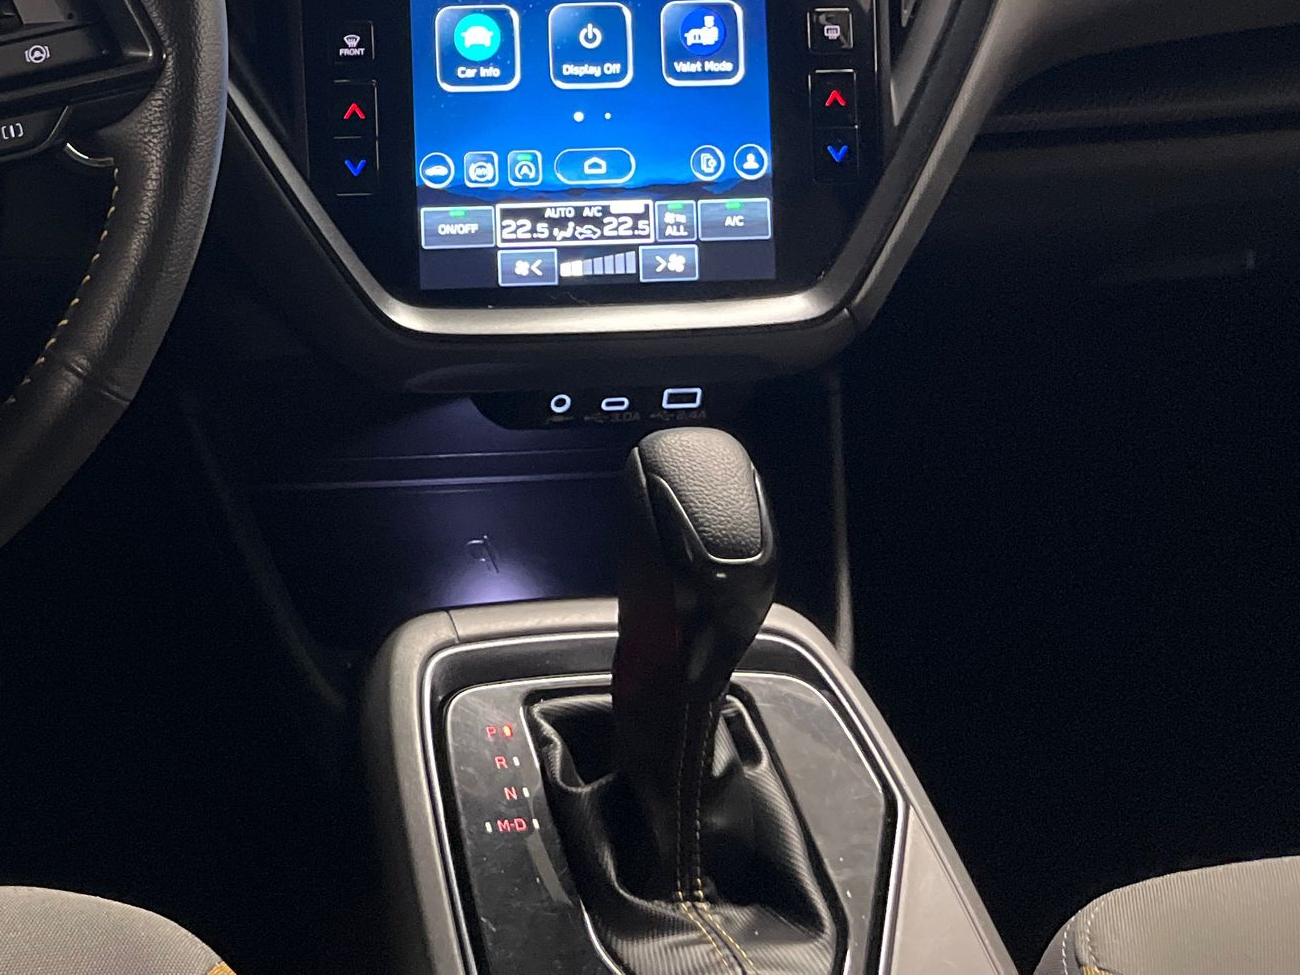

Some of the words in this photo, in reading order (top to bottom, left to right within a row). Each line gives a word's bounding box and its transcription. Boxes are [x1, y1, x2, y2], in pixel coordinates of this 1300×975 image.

[339, 48, 366, 57] FRONT
[457, 66, 478, 78] Car
[480, 66, 501, 78] Info
[562, 63, 602, 77] Display
[603, 62, 621, 75] Off
[673, 60, 703, 73] Valet
[704, 60, 733, 73] Mode
[544, 206, 576, 218] AUTO
[582, 205, 603, 218] A/C
[602, 216, 650, 237] 22.5
[724, 215, 745, 227] A/C
[437, 223, 480, 235] ON/OFF
[500, 218, 549, 239] 22.5
[665, 225, 688, 236] ALL
[485, 725, 497, 739] P
[494, 756, 509, 770] R
[503, 786, 518, 801] N
